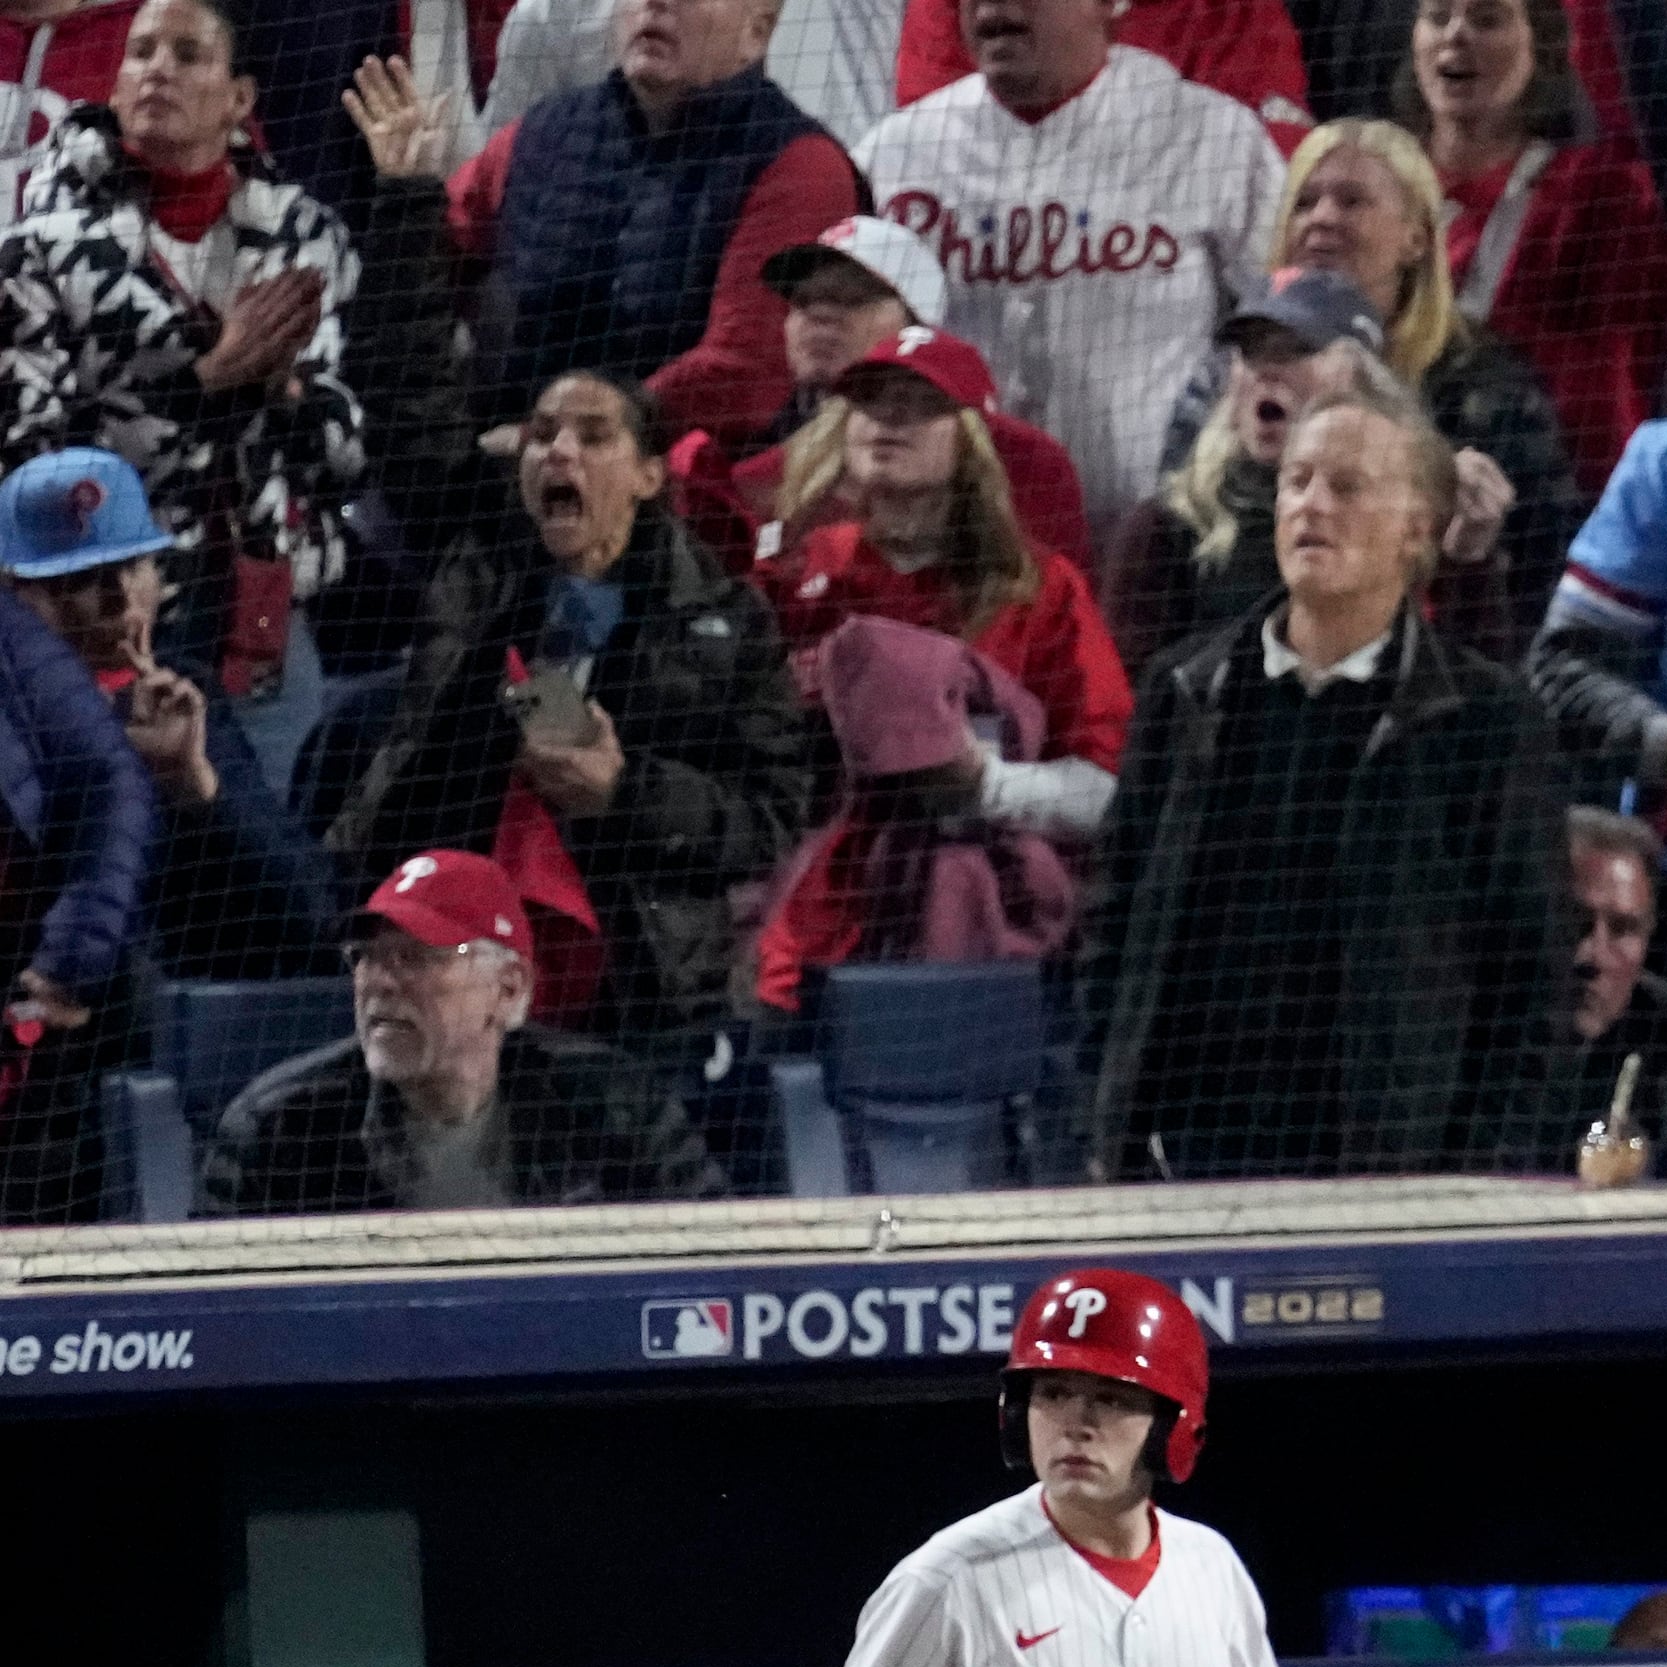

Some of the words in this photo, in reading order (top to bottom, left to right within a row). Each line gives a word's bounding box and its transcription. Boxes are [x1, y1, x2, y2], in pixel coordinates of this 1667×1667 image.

[394, 855, 438, 894] P
[1063, 1287, 1107, 1339] P
[1243, 1287, 1384, 1326] 2022
[50, 1319, 194, 1375] show.
